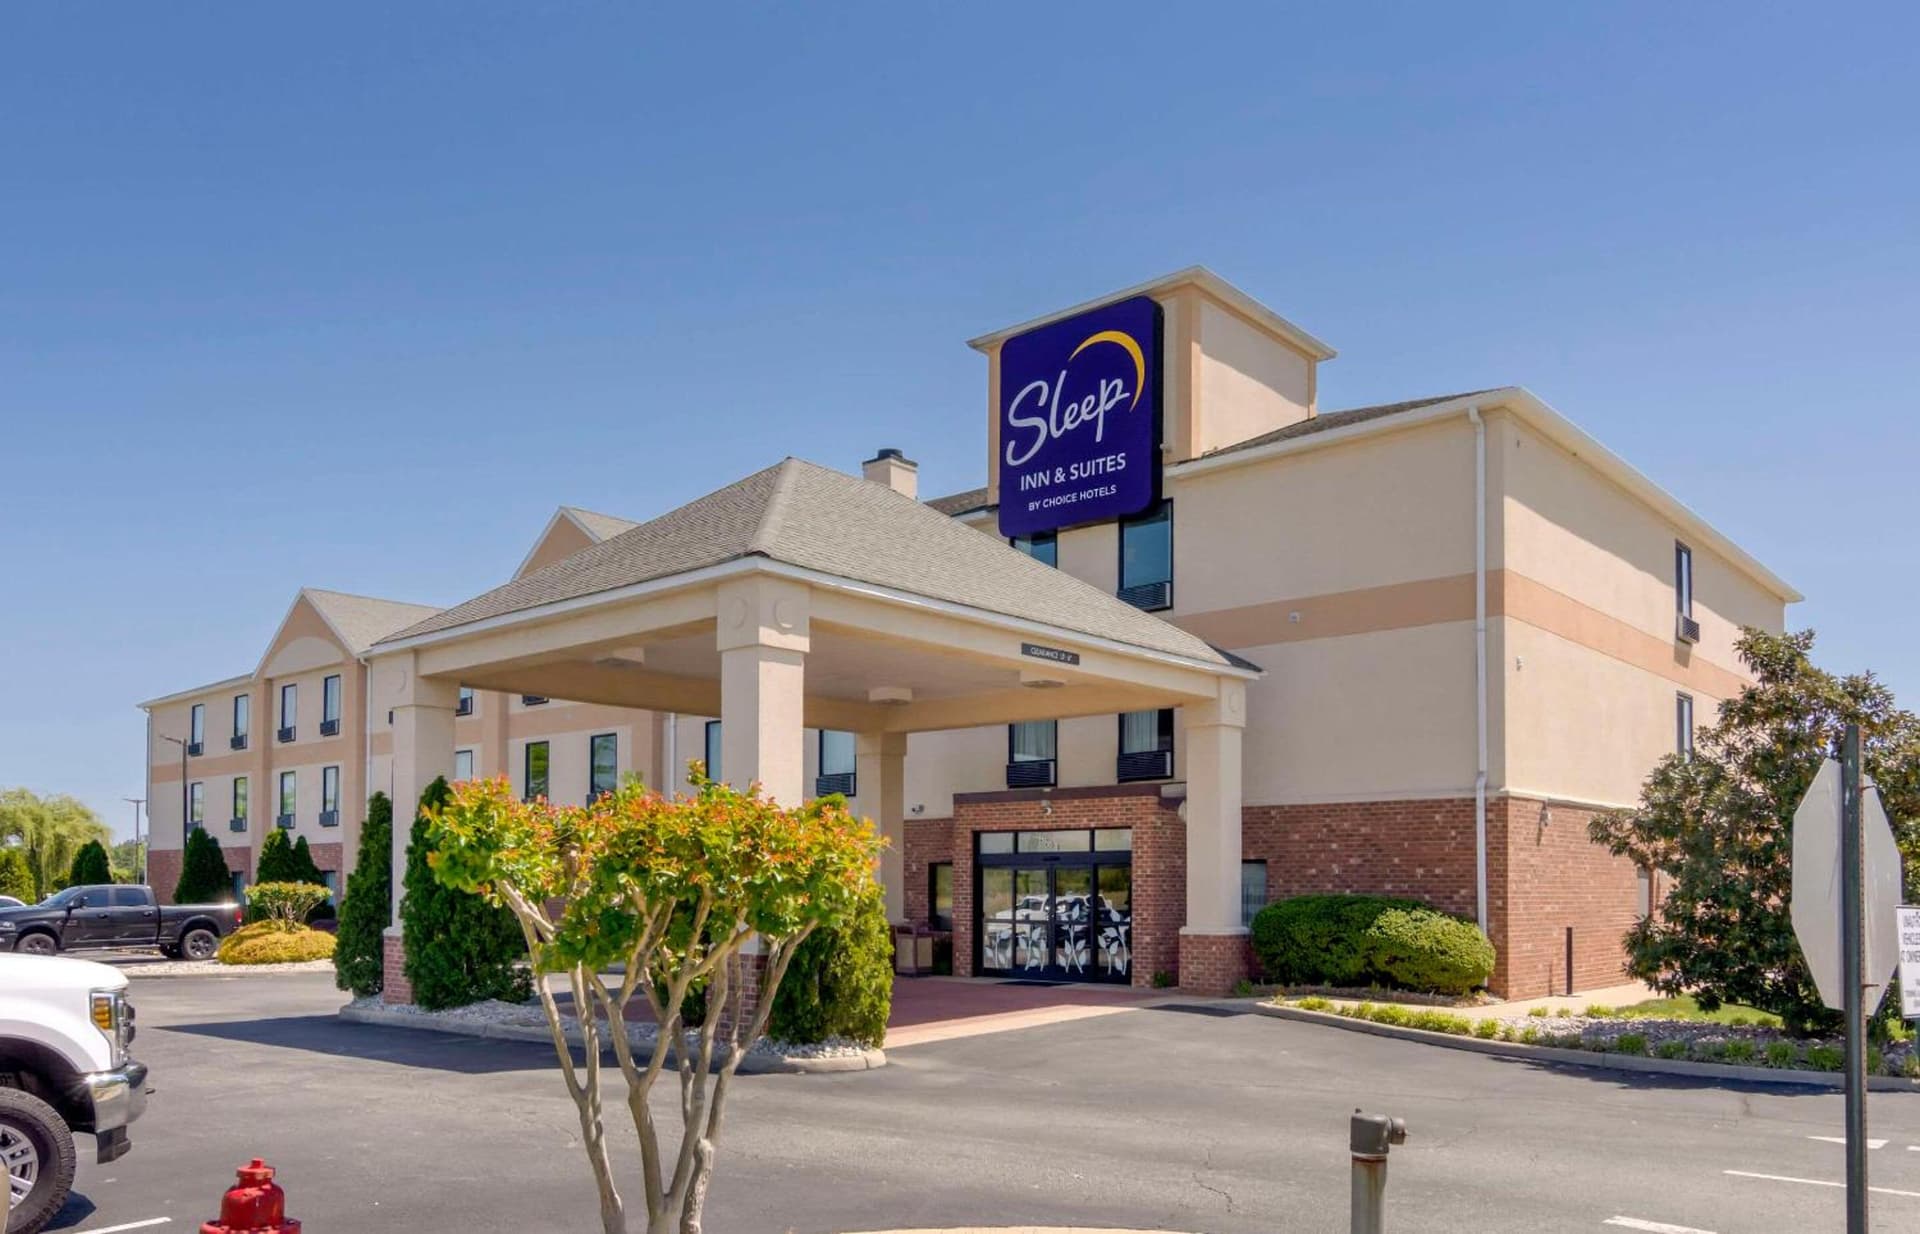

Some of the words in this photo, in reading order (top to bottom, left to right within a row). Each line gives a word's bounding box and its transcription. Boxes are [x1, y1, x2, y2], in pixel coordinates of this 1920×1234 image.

[1006, 370, 1130, 466] Sleep
[1020, 469, 1050, 491] INN
[1054, 467, 1066, 484] &
[1069, 452, 1126, 480] SUITES
[1028, 500, 1041, 511] BY
[1042, 492, 1078, 508] CHOICE
[1079, 484, 1117, 500] HOTELS
